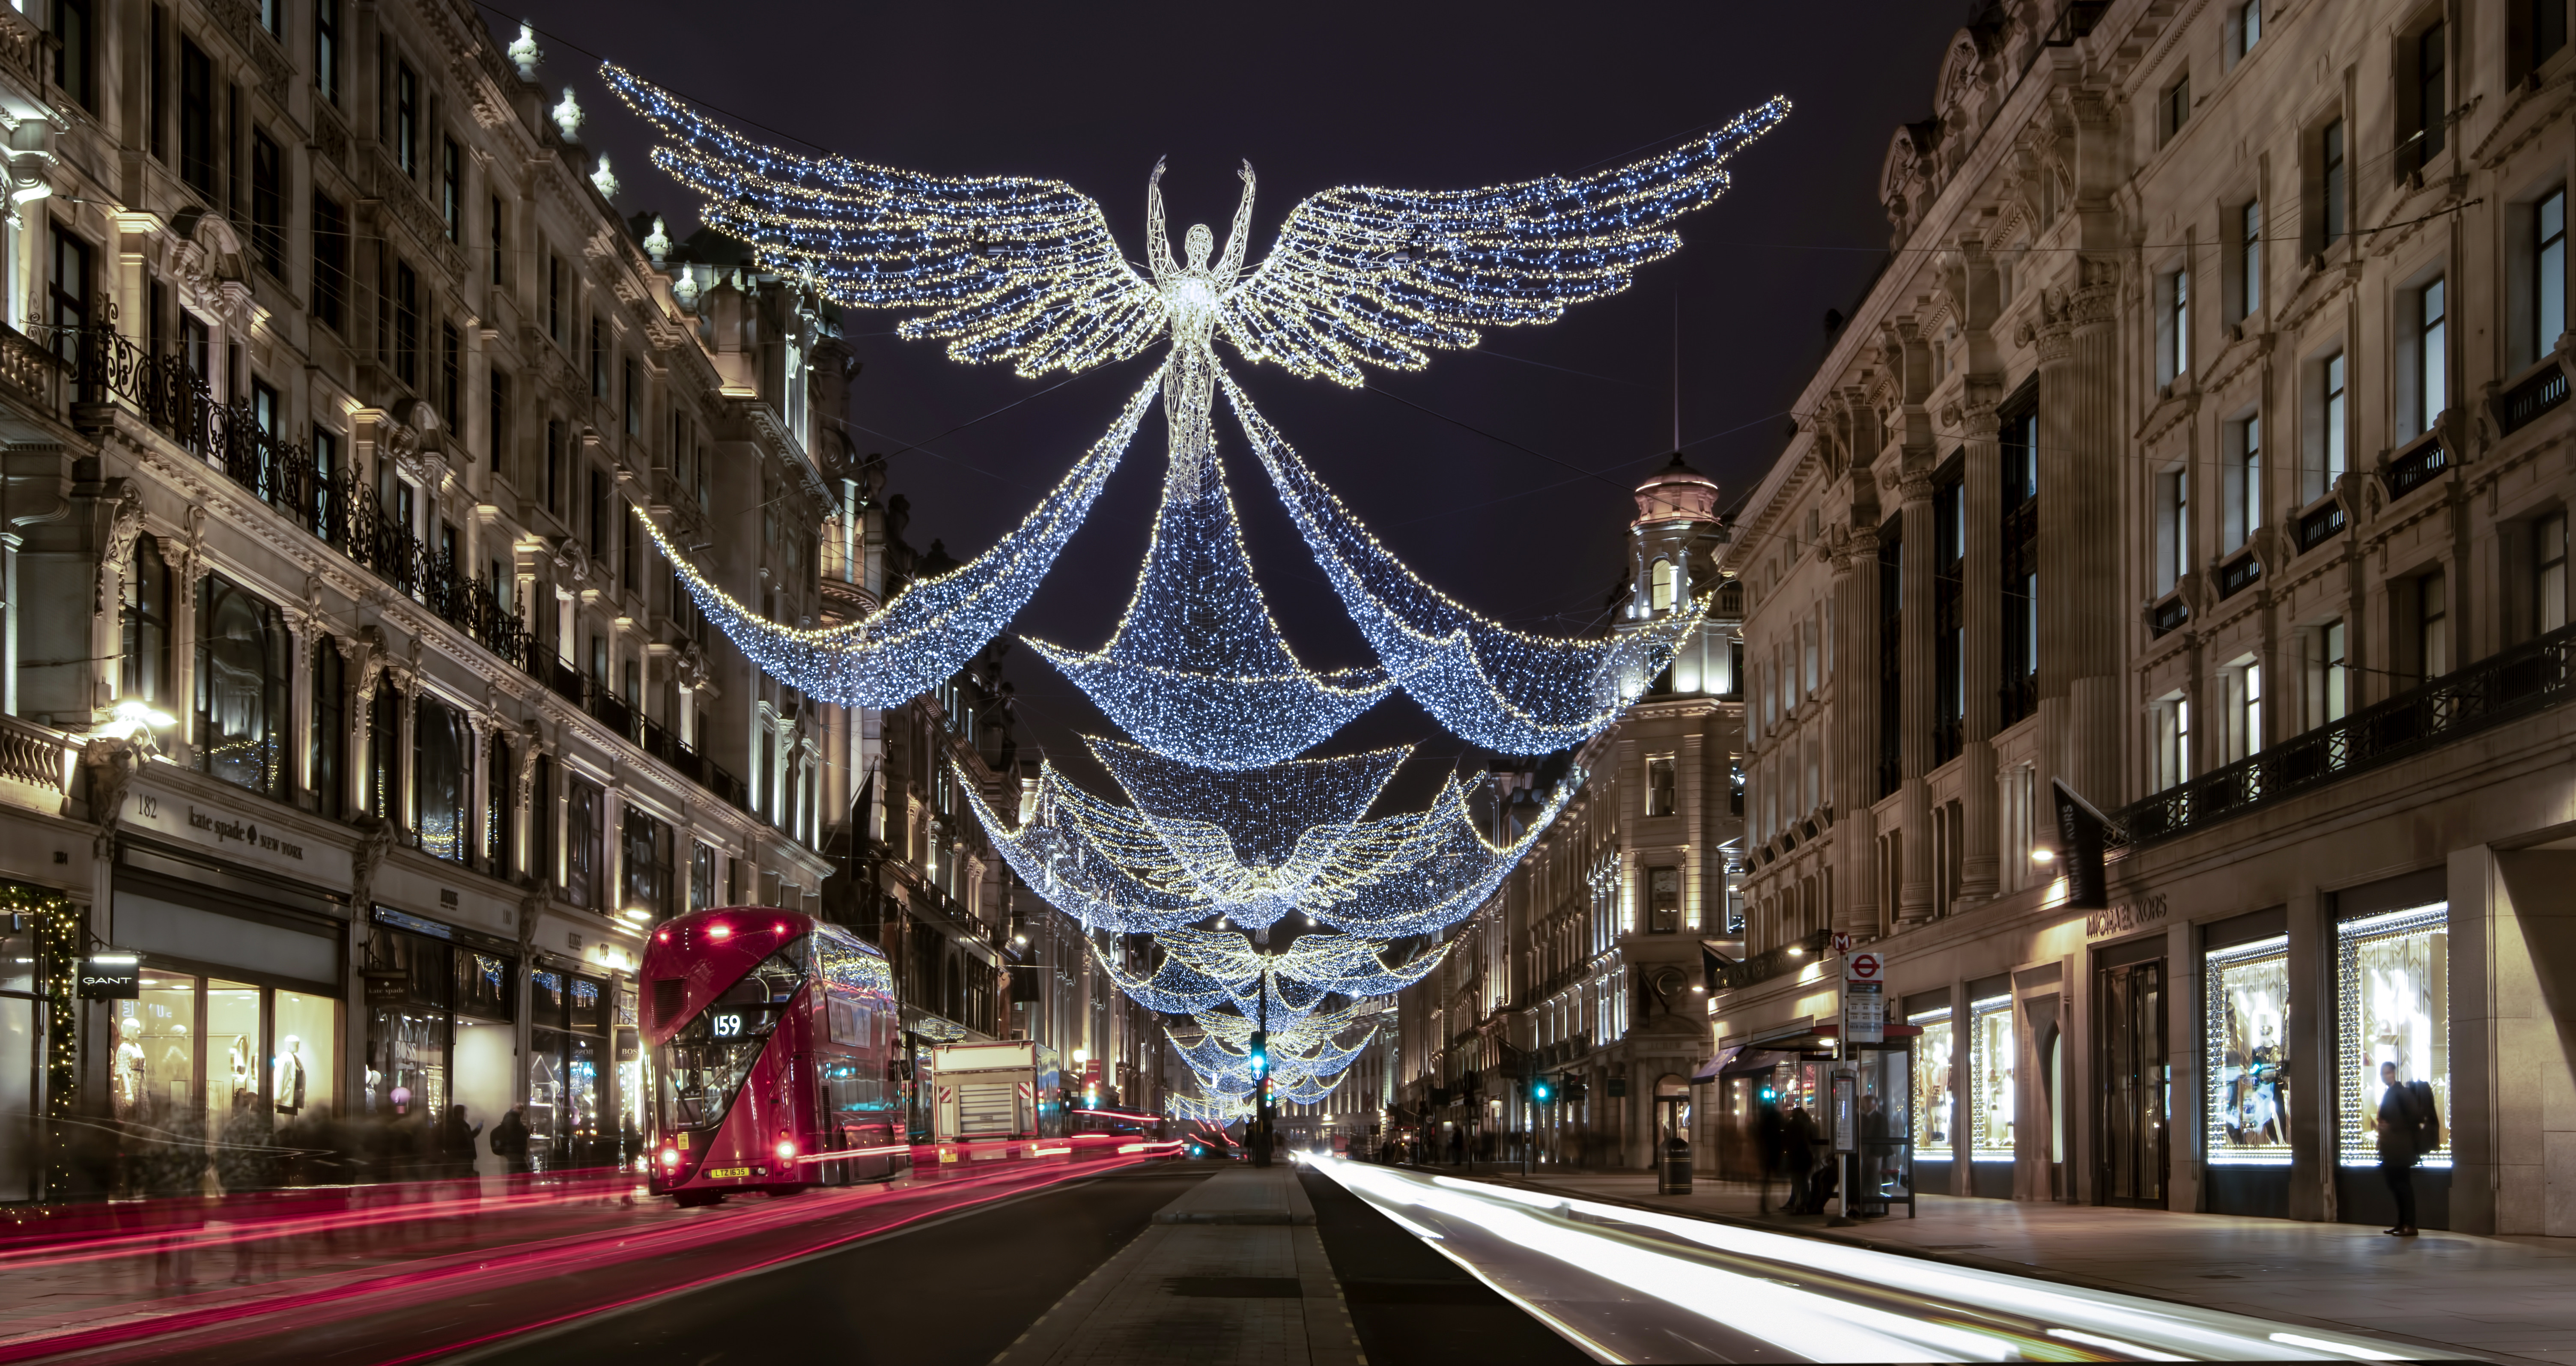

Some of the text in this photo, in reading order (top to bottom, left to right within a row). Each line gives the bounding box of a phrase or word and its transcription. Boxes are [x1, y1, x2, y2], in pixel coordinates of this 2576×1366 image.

[138, 793, 157, 819] 182
[188, 805, 303, 859] kate spade NEW YORK
[2063, 805, 2075, 840] KORS
[503, 909, 512, 925] 180
[2087, 893, 2167, 938] MICHAEL KORS
[1835, 935, 1849, 949] M
[385, 987, 405, 995] spade
[714, 1015, 740, 1035] 159
[395, 1041, 416, 1059] BOSS
